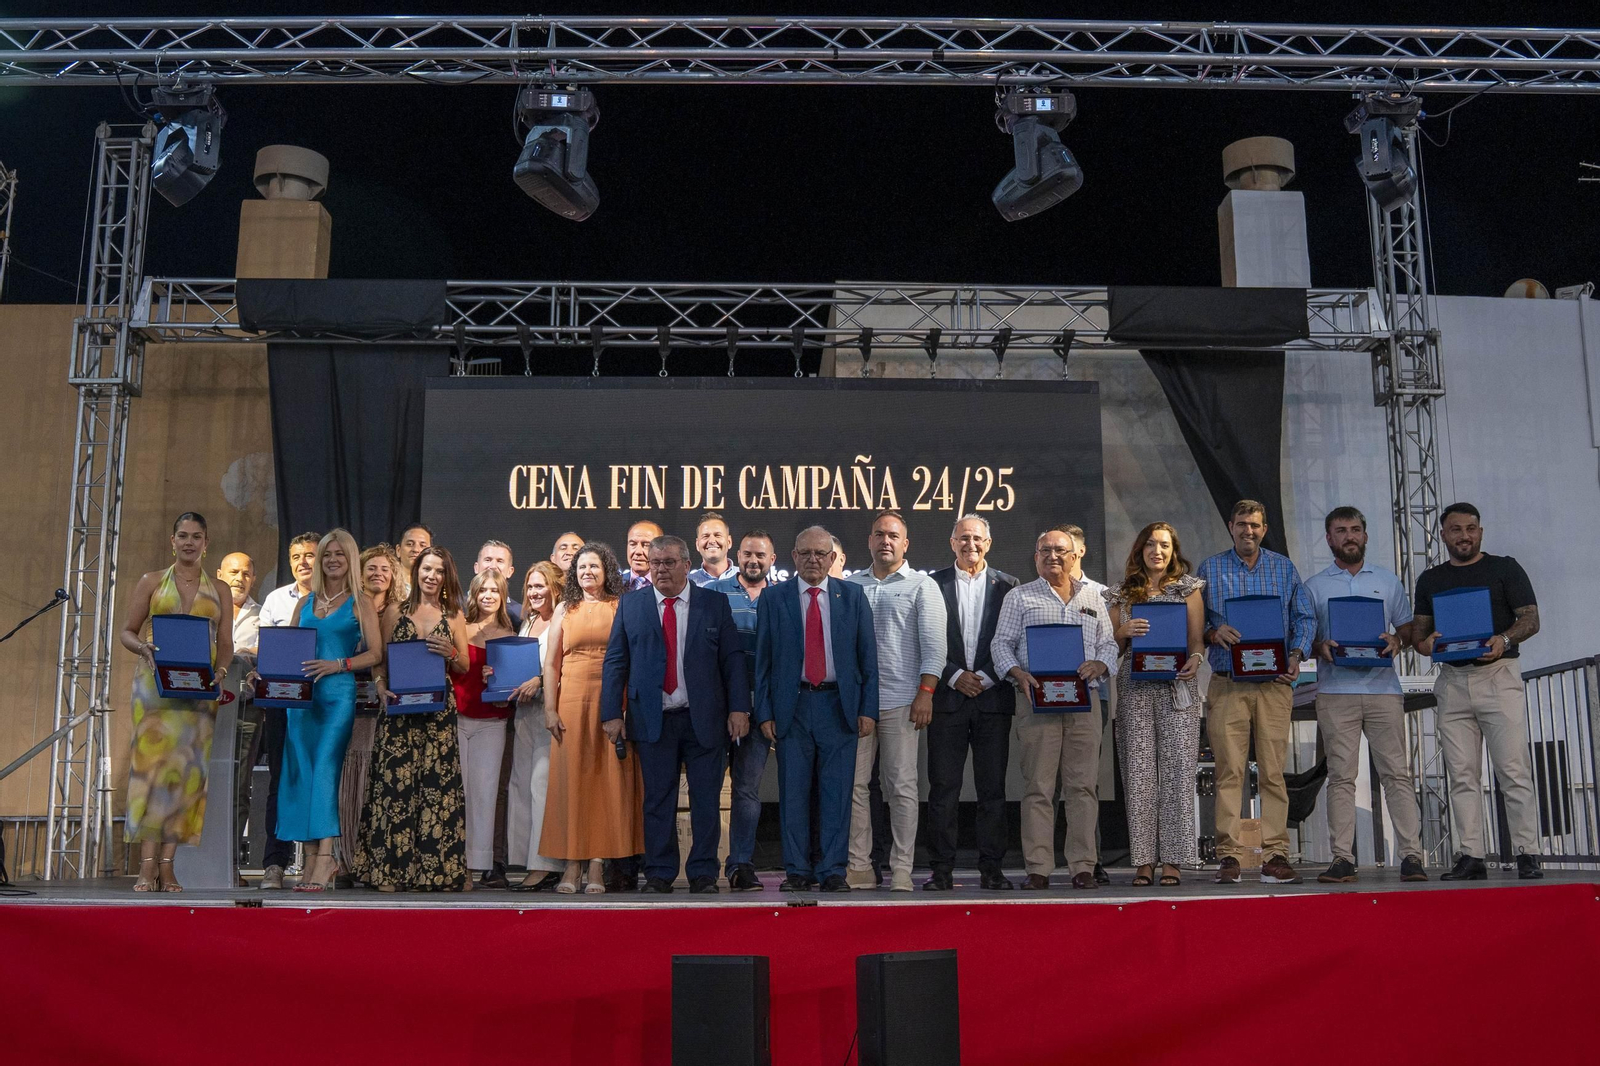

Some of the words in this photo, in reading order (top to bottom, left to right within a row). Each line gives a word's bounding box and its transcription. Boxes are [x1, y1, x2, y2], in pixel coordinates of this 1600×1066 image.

[508, 464, 597, 511] CENA
[607, 464, 669, 511] FIN
[680, 465, 725, 511] DE
[738, 454, 902, 512] CAMPAÑA
[912, 465, 1015, 517] 24/25
